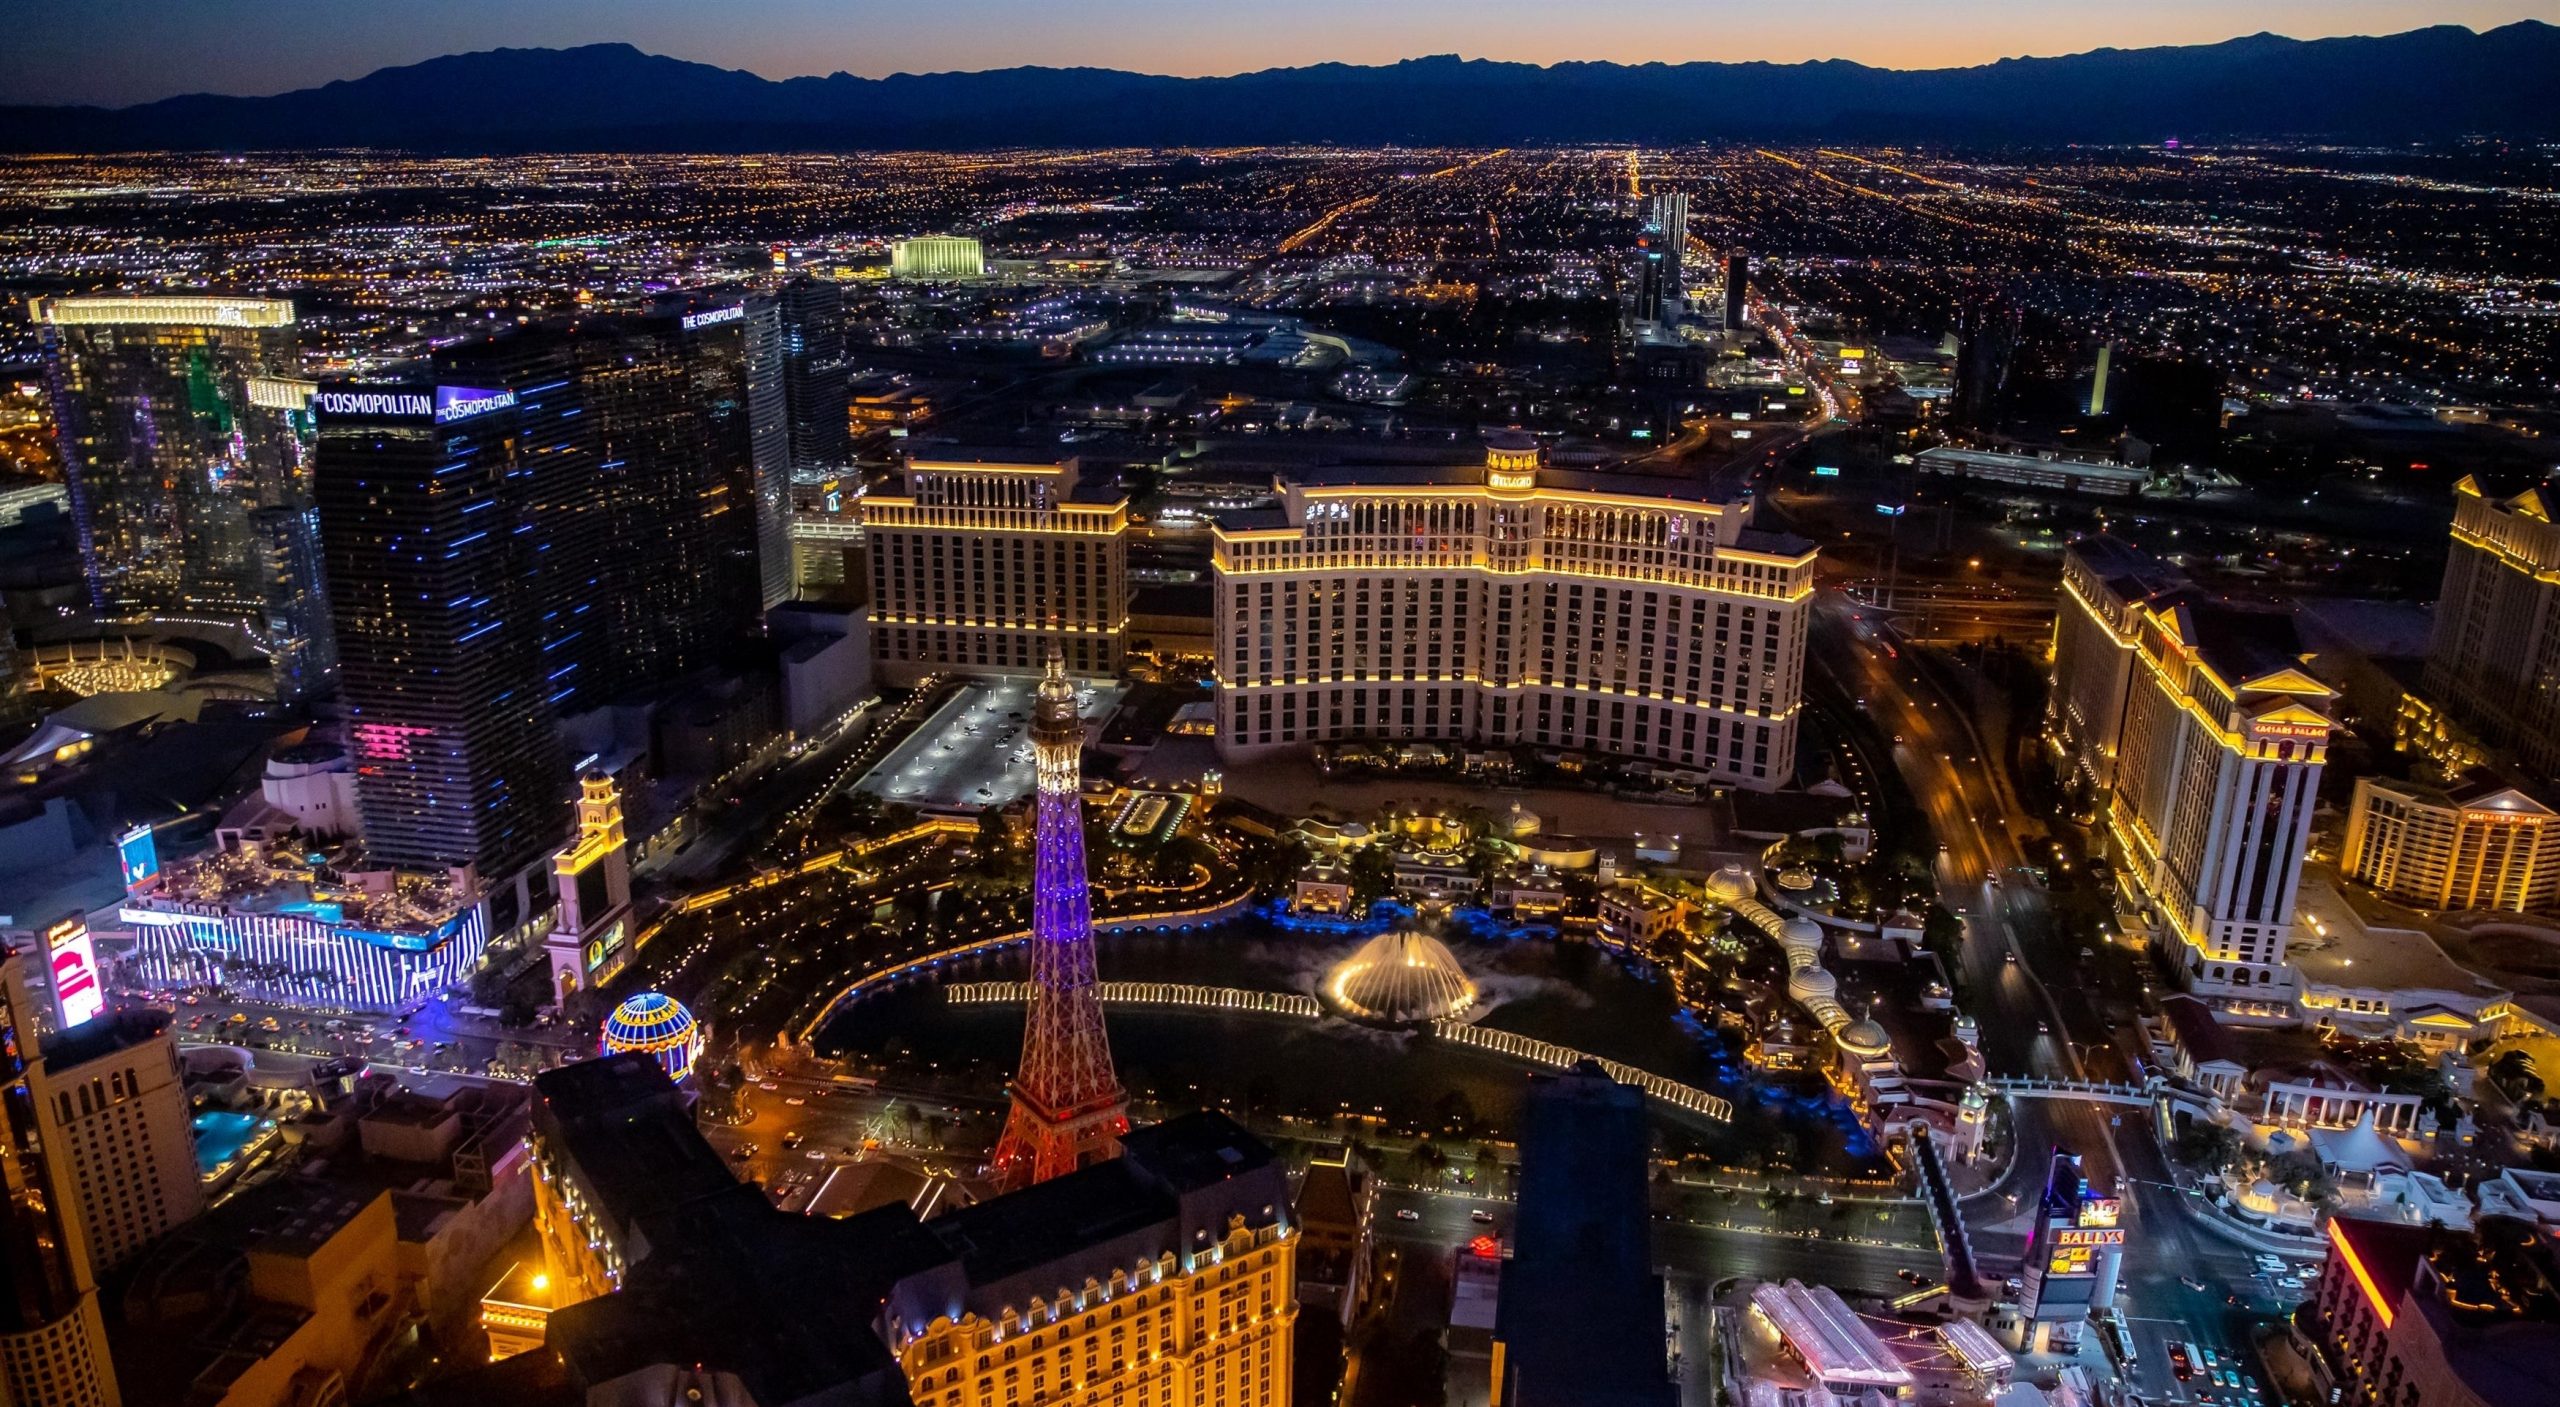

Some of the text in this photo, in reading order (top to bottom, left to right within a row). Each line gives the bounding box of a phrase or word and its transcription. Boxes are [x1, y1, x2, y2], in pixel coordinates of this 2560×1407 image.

[682, 306, 744, 328] THE COSMOPOLITAN
[312, 393, 431, 415] THE COSMOPOLITAN
[445, 392, 514, 420] COSMOPOLITAN
[2255, 725, 2327, 737] CAESARS PALACE
